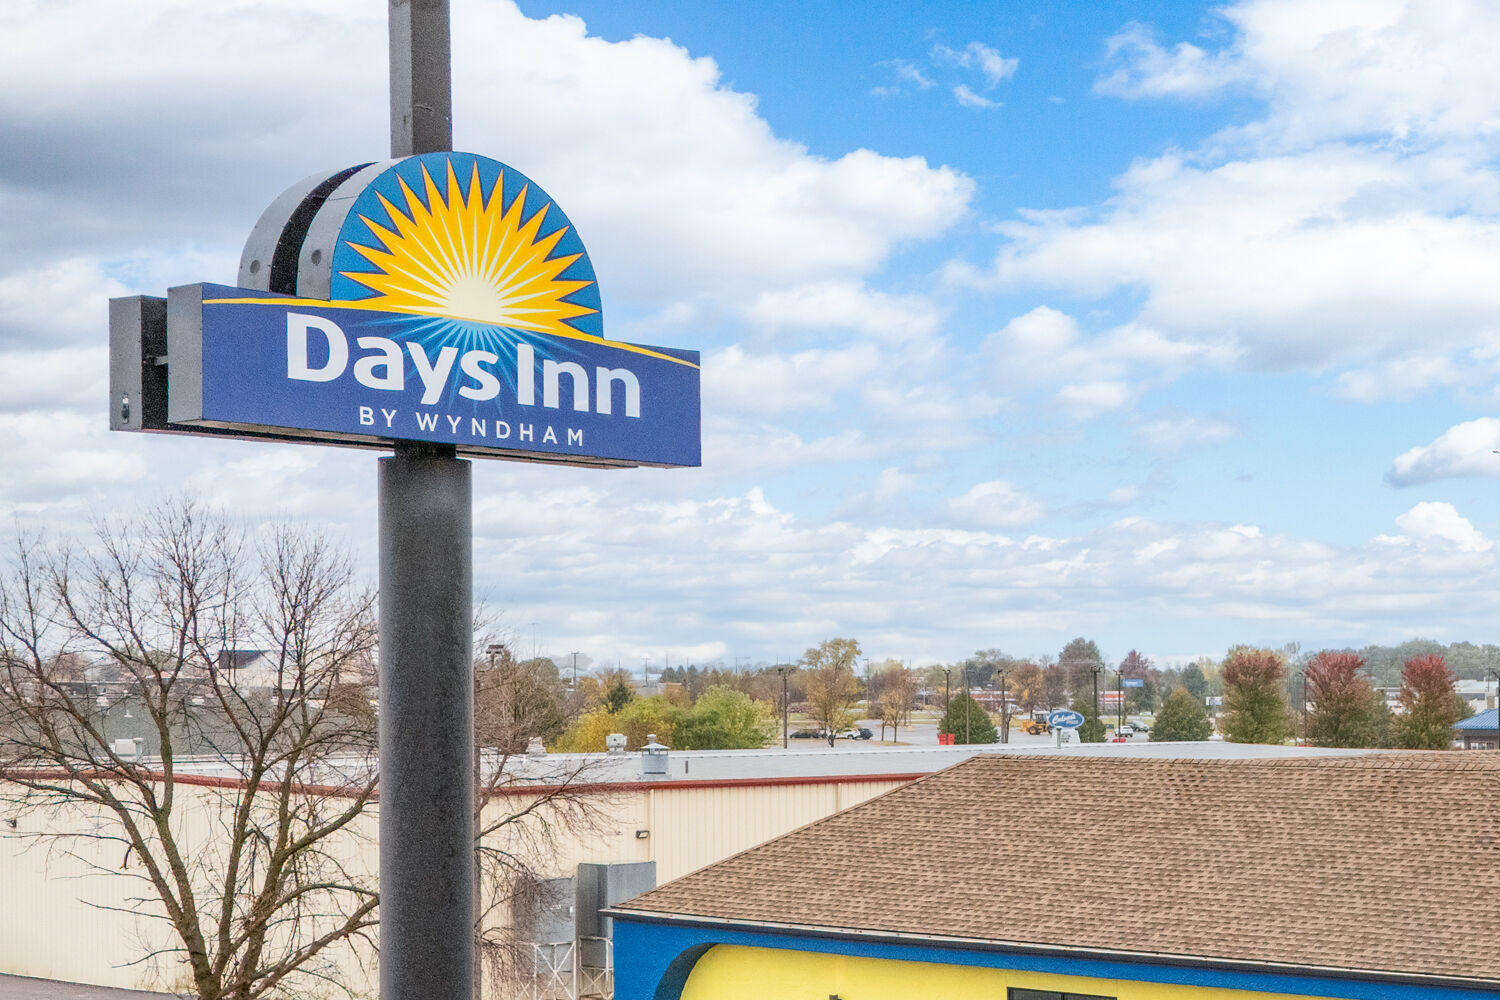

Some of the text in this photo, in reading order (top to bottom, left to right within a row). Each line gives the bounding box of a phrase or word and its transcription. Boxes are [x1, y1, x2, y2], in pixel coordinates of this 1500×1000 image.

[287, 312, 640, 418] Days Inn
[359, 406, 583, 446] BY WYNDHAM
